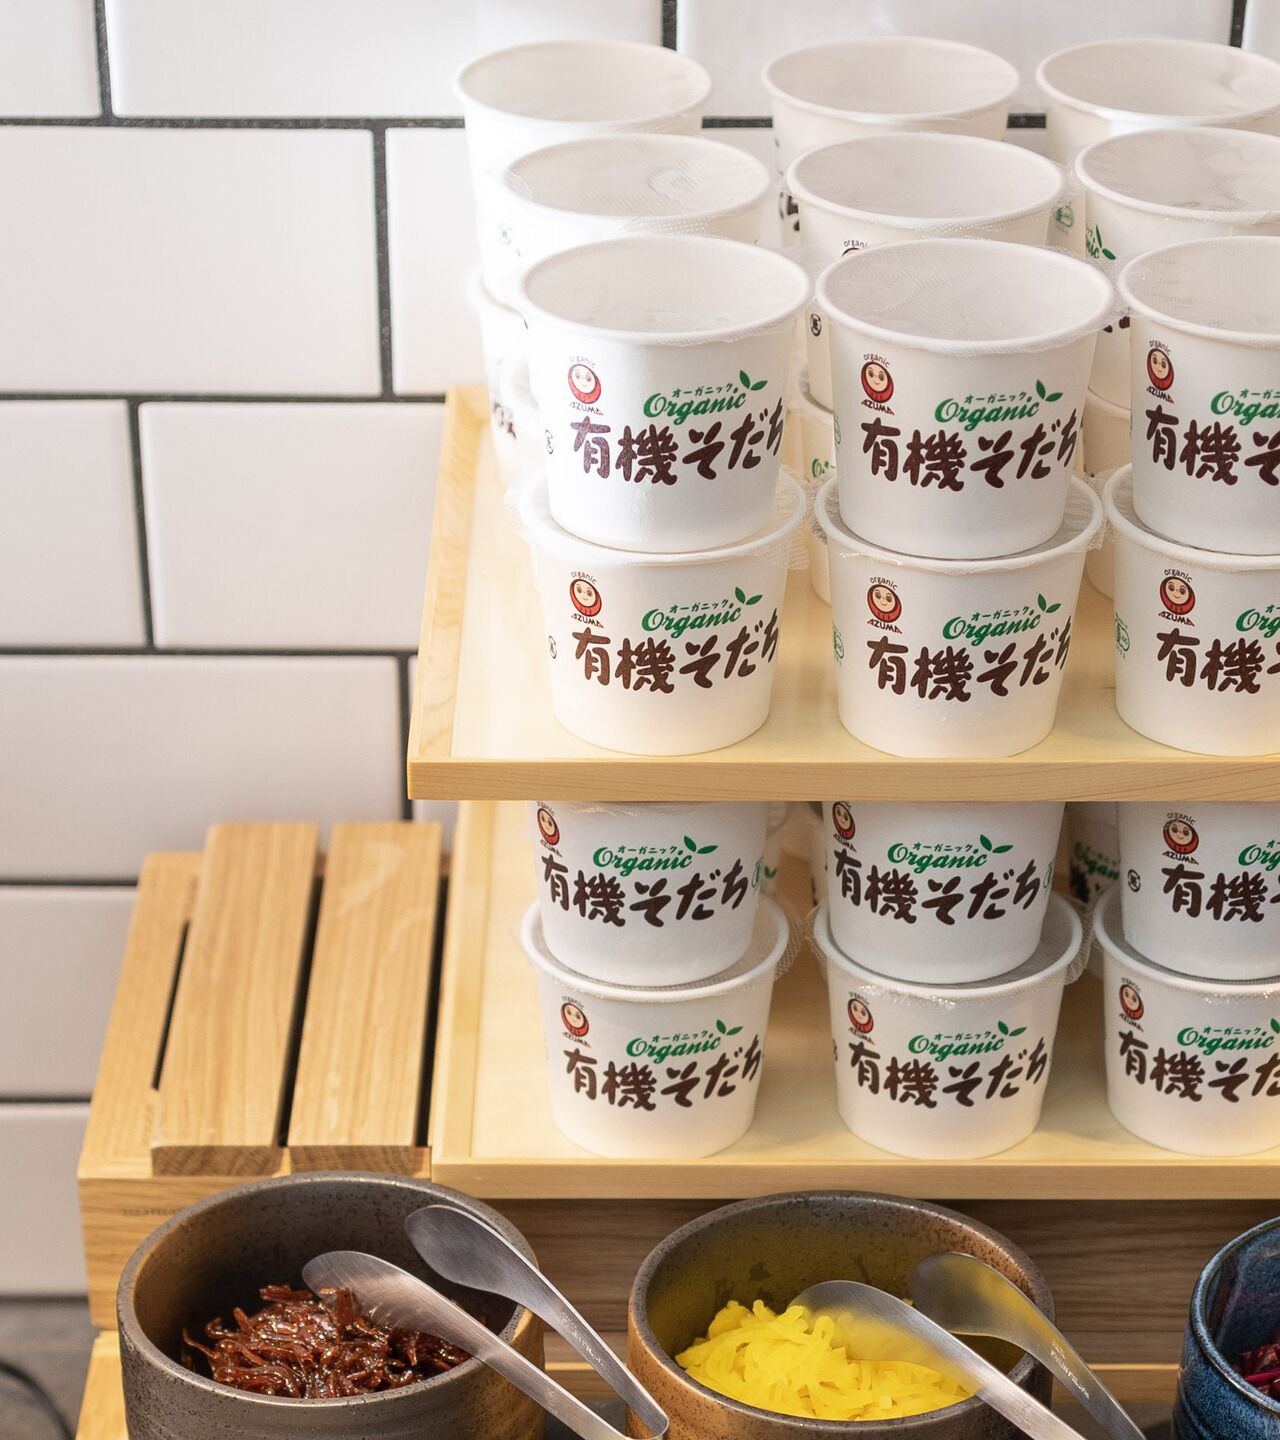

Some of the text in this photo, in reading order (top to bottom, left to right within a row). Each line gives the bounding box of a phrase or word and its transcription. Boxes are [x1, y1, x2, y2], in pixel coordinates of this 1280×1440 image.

[863, 353, 891, 368] organic
[672, 383, 732, 397] オーガニック
[964, 392, 1027, 404] オーガニック
[1146, 386, 1175, 404] AZUMA
[643, 387, 746, 425] Organic
[861, 399, 895, 415] AZUMA
[935, 396, 1040, 431] Organic
[570, 397, 784, 486] 有機そだち
[861, 409, 1077, 491] 有機そだち
[870, 577, 898, 590] organic
[1164, 569, 1192, 582] organic
[670, 599, 728, 613] オーガニック
[971, 606, 1030, 620] オーガニック
[571, 614, 604, 628] AZUMA
[642, 603, 742, 638] Organic
[867, 619, 903, 634] AZUMA
[1158, 611, 1195, 626] AZUMA
[943, 610, 1041, 646] Organic
[572, 608, 778, 694] 有機そだち
[617, 846, 677, 854] オーガニック
[913, 842, 973, 852] オーガニック
[593, 847, 693, 876] Organic
[888, 843, 987, 874] Organic
[1162, 851, 1199, 865] AZUMA
[542, 855, 748, 927] 有機そだち
[834, 849, 1040, 925] 有機そだち
[652, 1030, 707, 1043] オーガニック
[934, 1031, 990, 1041] オーガニック
[1203, 1027, 1262, 1036] オーガニック
[626, 1034, 721, 1064] Organic
[908, 1034, 1004, 1062] Organic
[1177, 1028, 1275, 1056] Organic
[564, 1034, 761, 1111] 有機そだち
[849, 1037, 1048, 1108] 有機そだち
